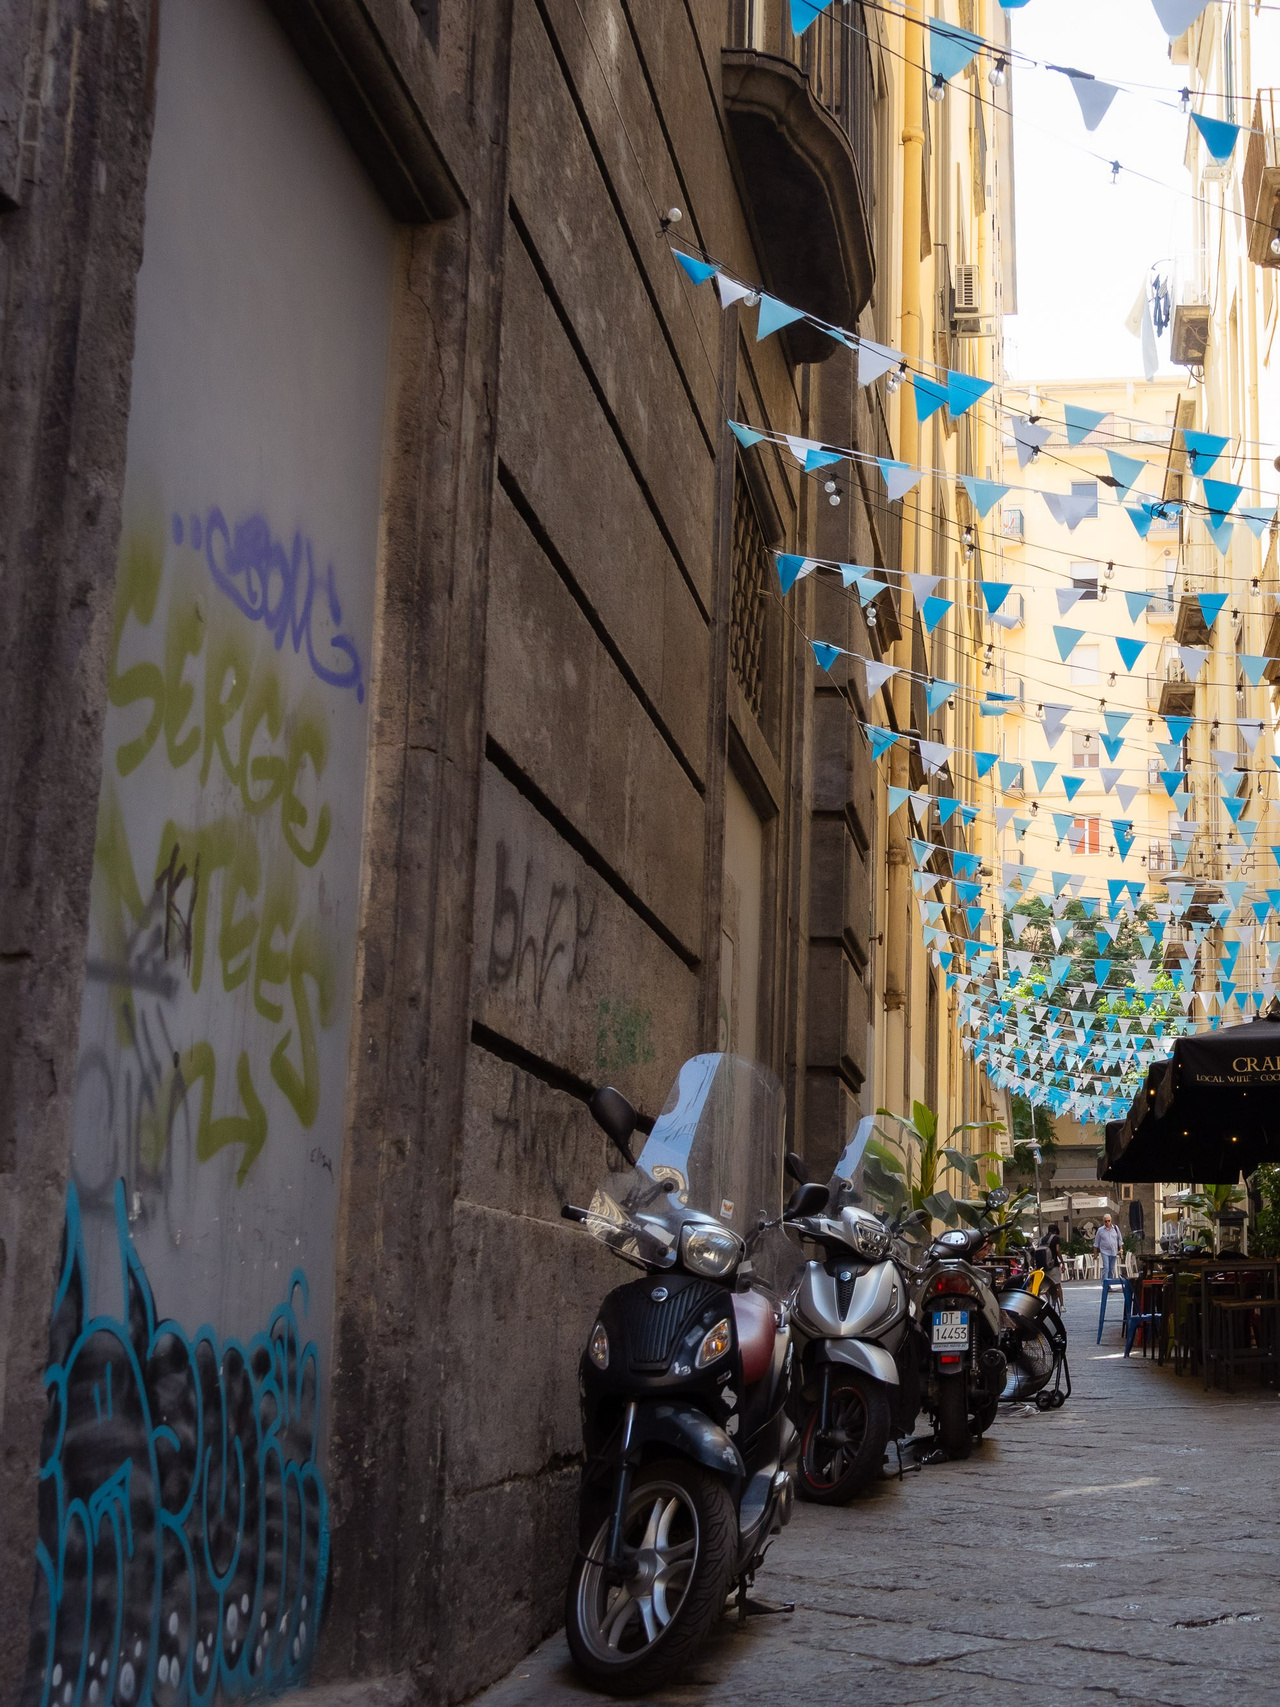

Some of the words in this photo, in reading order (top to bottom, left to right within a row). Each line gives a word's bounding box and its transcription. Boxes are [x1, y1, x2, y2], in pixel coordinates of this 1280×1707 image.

[1196, 1073, 1225, 1083] LOCAL
[1226, 1074, 1252, 1083] WINE
[942, 1313, 955, 1324] DT
[936, 1328, 967, 1340] 14453
